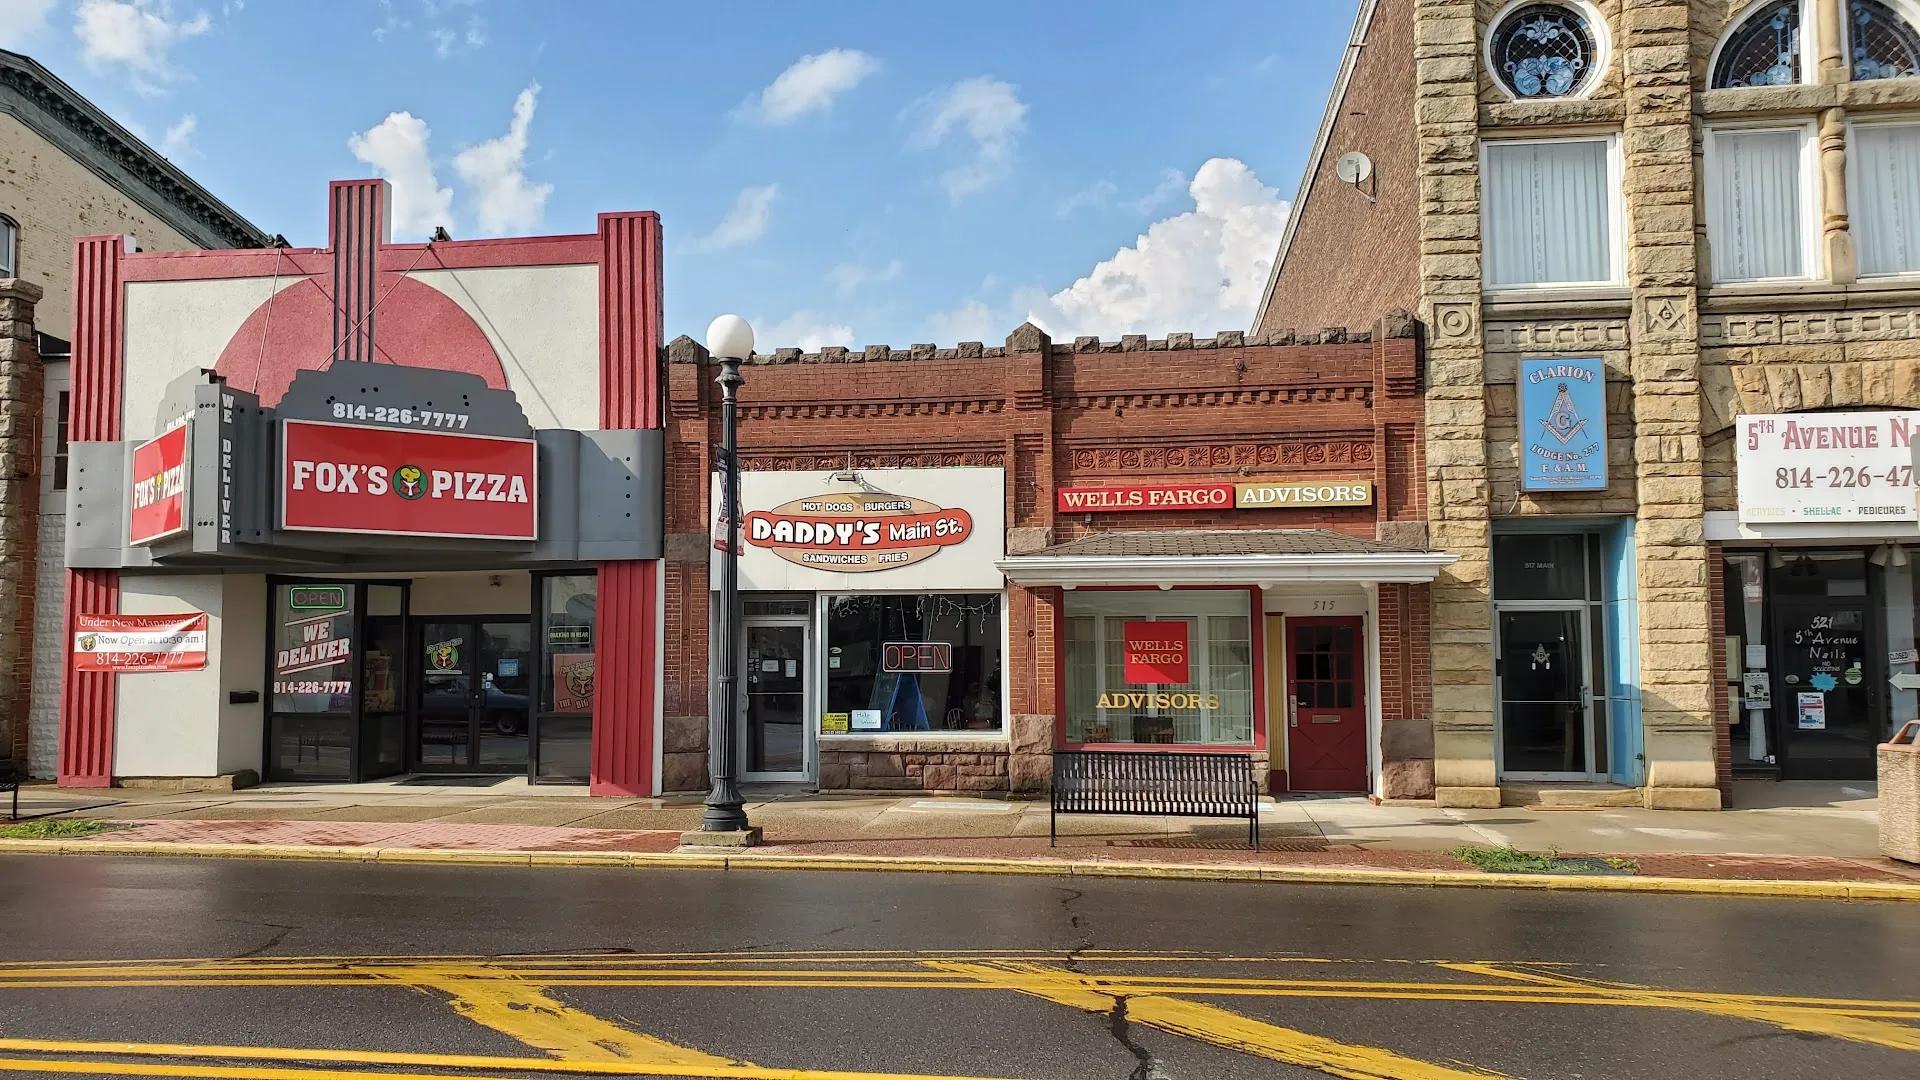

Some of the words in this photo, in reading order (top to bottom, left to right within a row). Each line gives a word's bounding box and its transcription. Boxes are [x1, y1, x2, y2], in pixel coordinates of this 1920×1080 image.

[1529, 364, 1595, 384] CLARION
[221, 393, 235, 424] WE
[332, 402, 469, 429] 814-226-7777
[1748, 419, 1775, 450] 5TH
[1781, 420, 1879, 449] AVENUE
[1530, 443, 1563, 461] LODGE
[1582, 442, 1599, 457] 277
[1554, 463, 1562, 472] &
[133, 476, 156, 510] FOX'S
[162, 463, 185, 500] PIZZA
[292, 460, 388, 495] FOX'S
[431, 470, 528, 503] PIZZA
[221, 438, 233, 544] DELIVER
[1063, 490, 1144, 508] WELLS
[1147, 488, 1228, 506] FARGO
[1240, 484, 1368, 504] ADVISORS
[801, 502, 823, 511] HOT
[825, 502, 853, 512] DOGS
[863, 501, 912, 511] BURGERS
[751, 517, 882, 545] DADDY'S
[888, 522, 931, 541] Main
[934, 518, 964, 537] St.
[801, 552, 868, 564] SANDWICHES
[878, 552, 908, 563] FRIES
[294, 591, 341, 606] OPEN
[1312, 600, 1336, 611] 515
[79, 617, 110, 627] Under
[112, 618, 134, 628] New
[137, 617, 204, 630] Managemnt!
[1810, 616, 1834, 629] 521
[303, 621, 330, 643] WE
[1812, 632, 1859, 645] Avenue
[98, 635, 118, 645] Now
[120, 635, 145, 648] Open
[159, 635, 183, 645] 10:30
[185, 634, 200, 644] am
[1129, 640, 1184, 652] WELLS
[96, 651, 185, 665] 814-226-7777
[277, 637, 350, 669] DELIVER
[885, 645, 949, 670] OPEN
[1130, 653, 1184, 665] FARGO
[1809, 646, 1846, 660] Nails
[273, 681, 351, 694] 814-226-7777
[575, 698, 589, 710] BIG
[1095, 692, 1220, 710] ADVISORS
